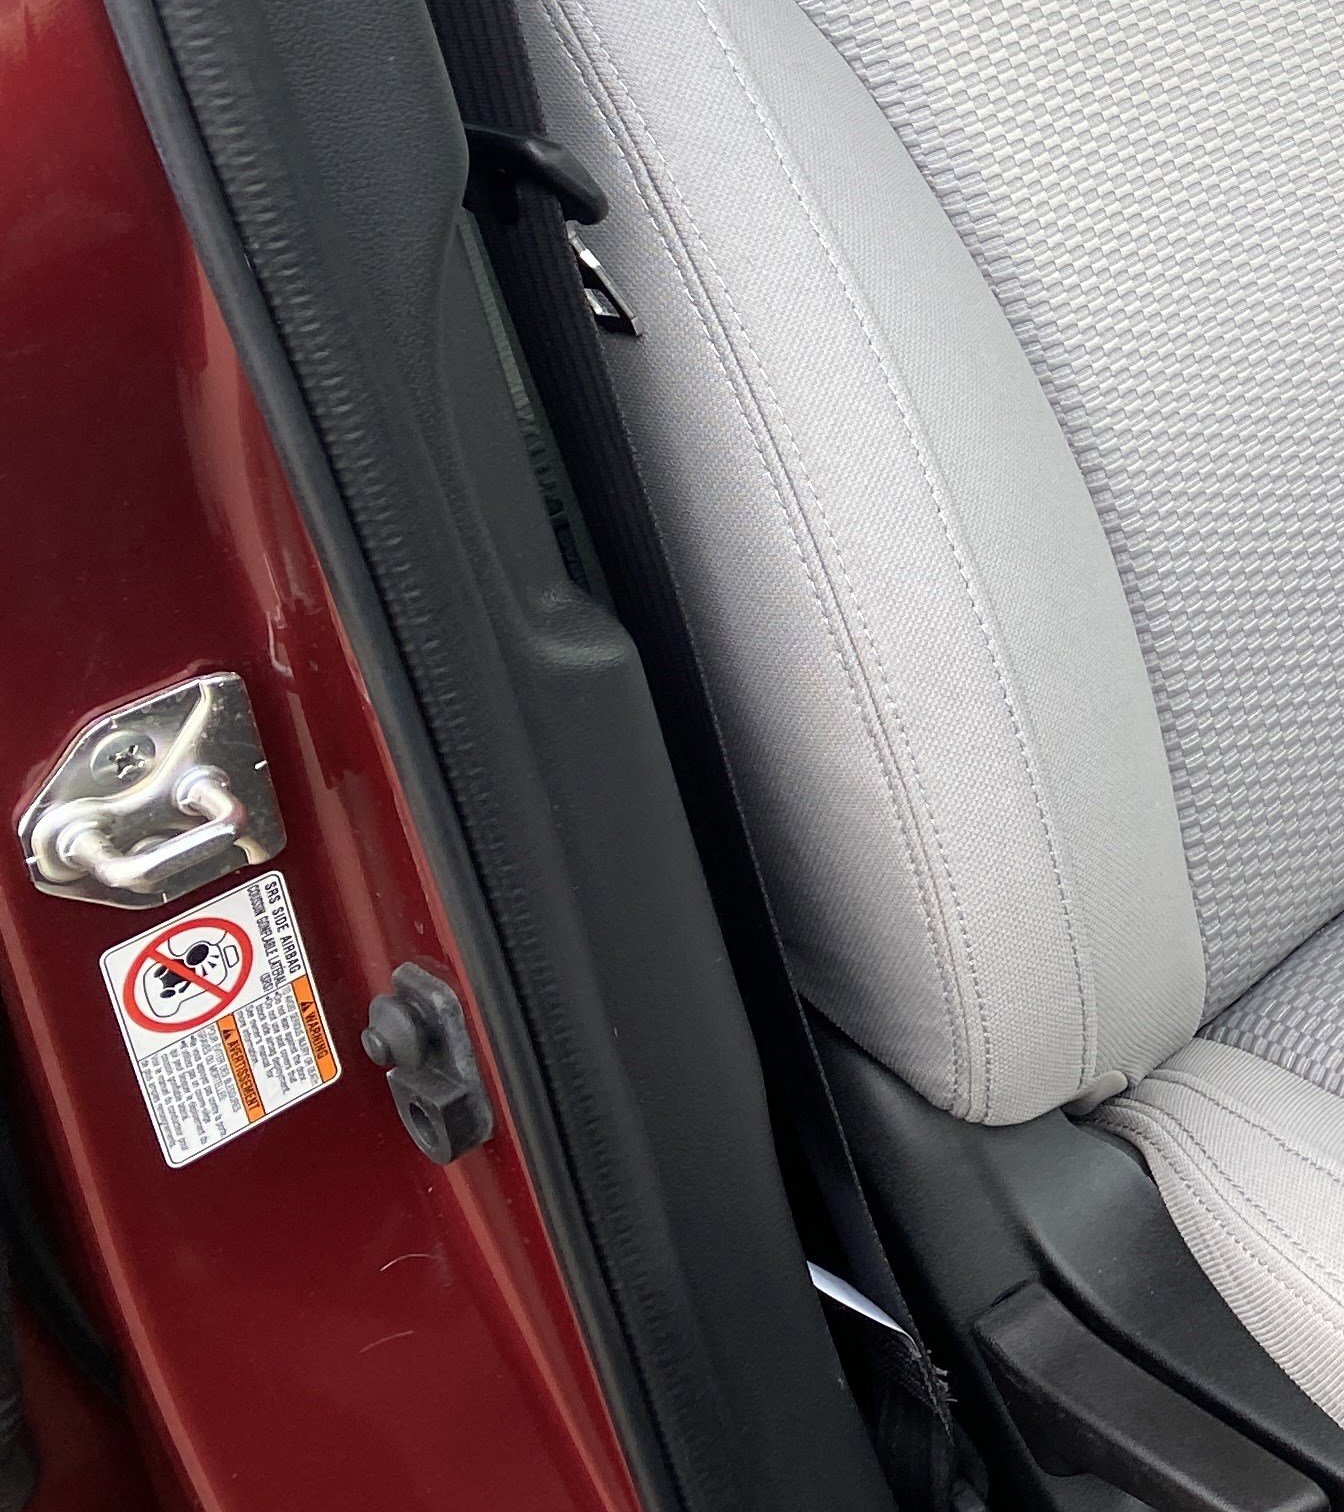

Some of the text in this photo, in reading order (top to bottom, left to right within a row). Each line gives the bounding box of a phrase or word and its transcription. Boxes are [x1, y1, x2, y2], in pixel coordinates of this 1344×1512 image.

[263, 879, 302, 974] SRS SIDE AIRBAG
[304, 1010, 328, 1060] WARNING
[226, 1037, 260, 1113] AVERTISSEMENT
